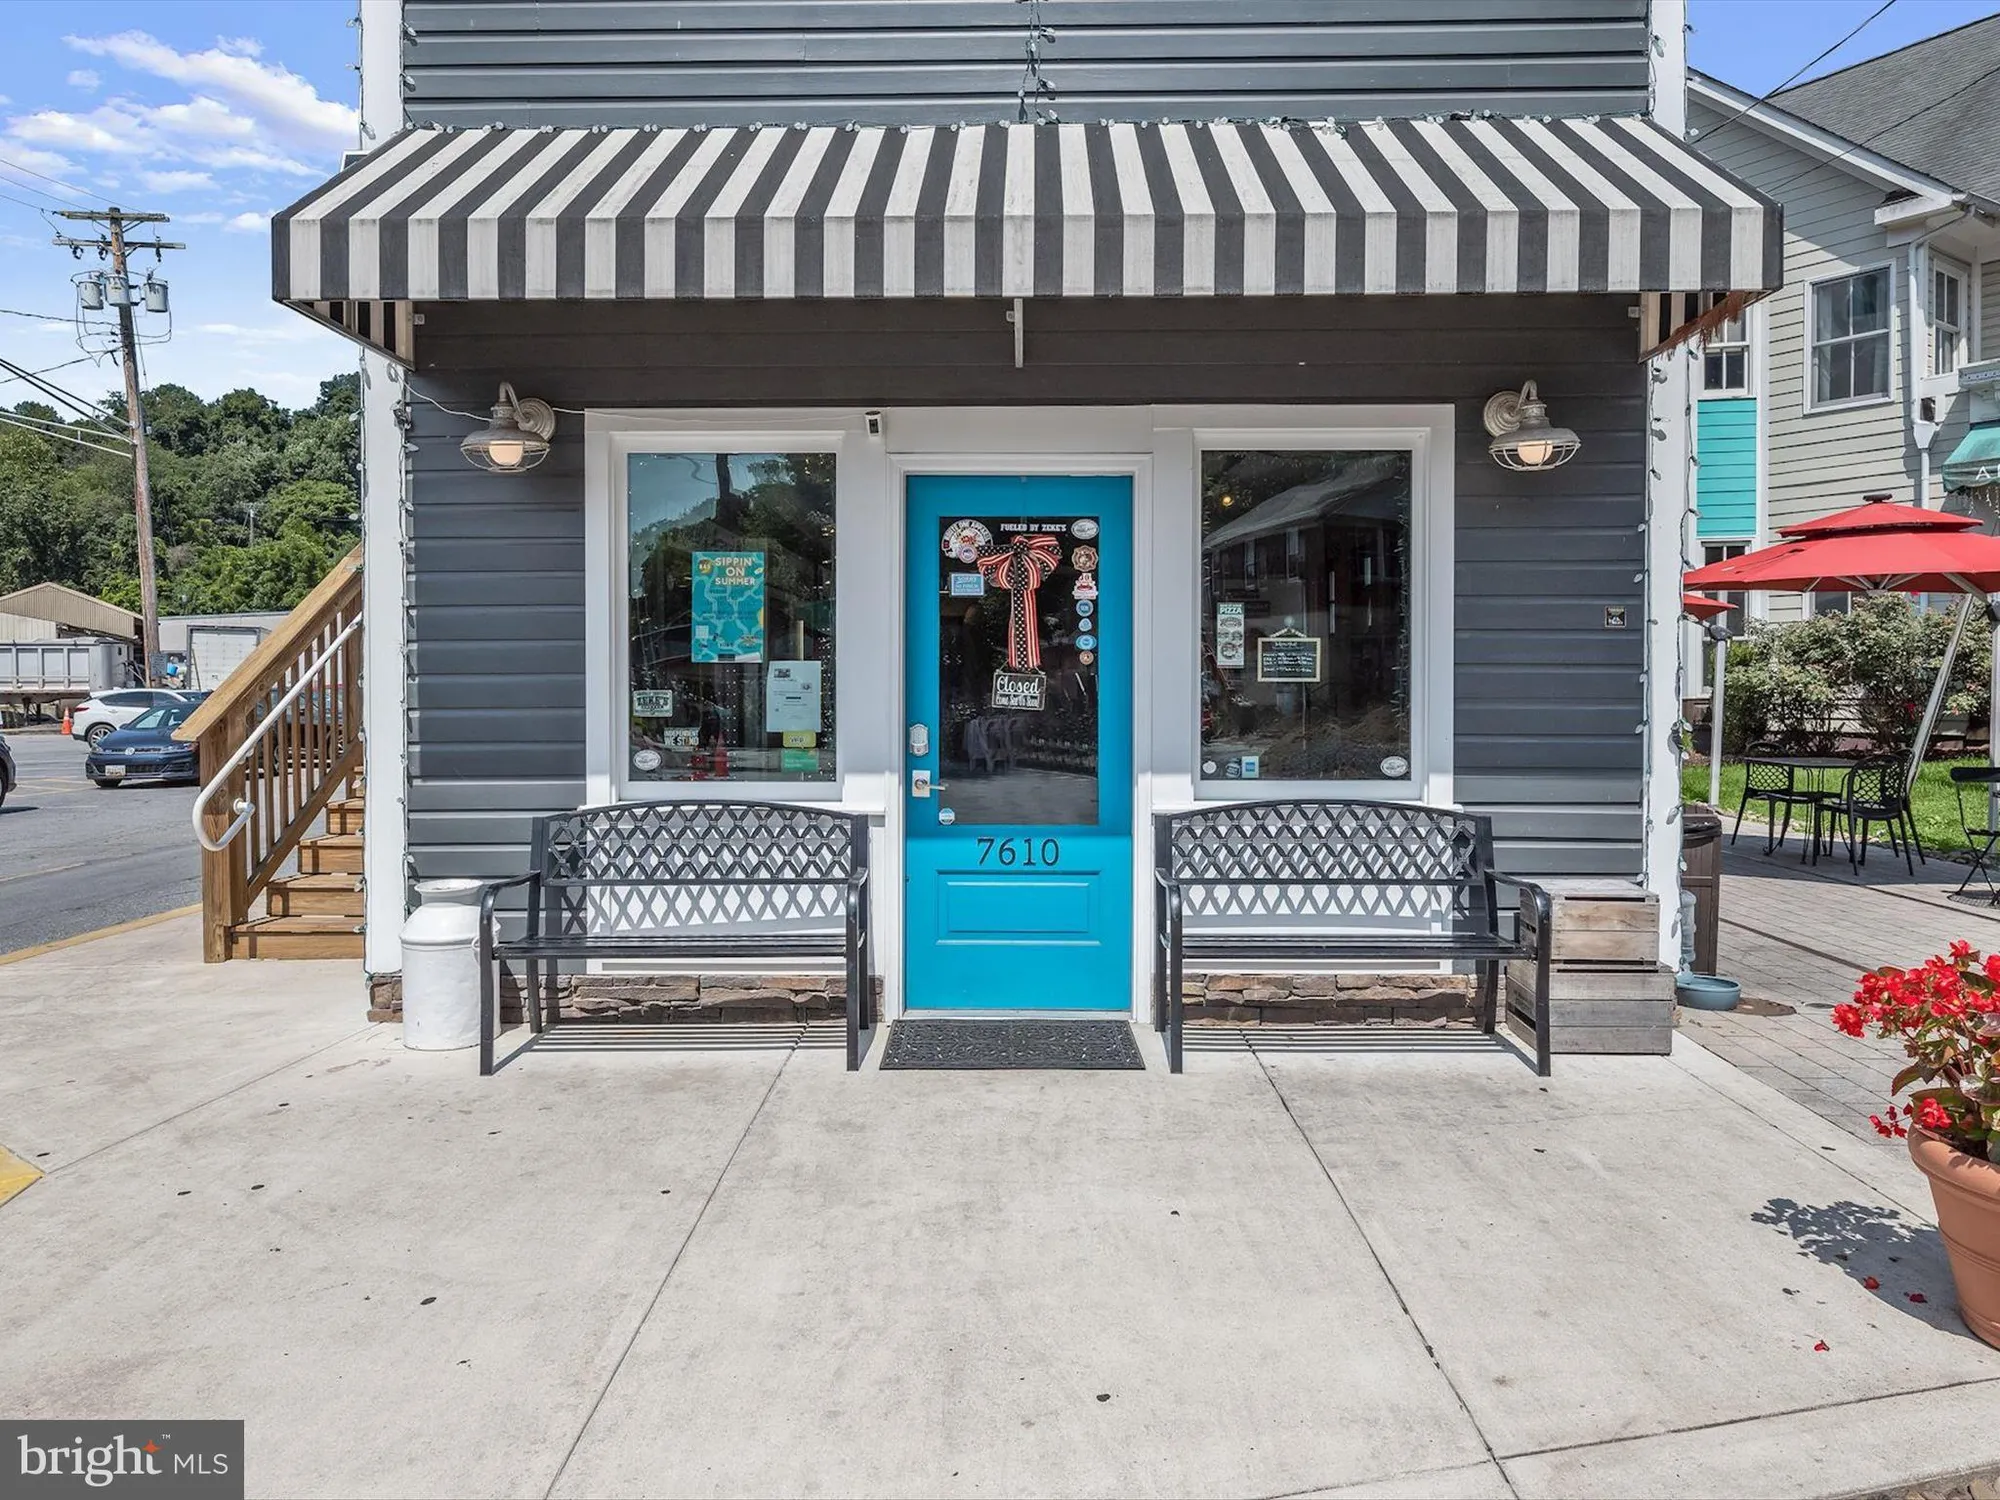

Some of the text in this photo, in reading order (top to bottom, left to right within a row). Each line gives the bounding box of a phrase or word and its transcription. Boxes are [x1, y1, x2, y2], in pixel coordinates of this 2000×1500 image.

[1000, 523, 1027, 532] FUELED
[1029, 523, 1039, 532] BY
[1041, 523, 1067, 532] ZEKE'S
[715, 557, 755, 567] SIPPIN'
[726, 567, 745, 576] ON
[715, 577, 755, 586] SUMMER
[996, 675, 1041, 693] Closed
[977, 837, 1060, 867] 7610
